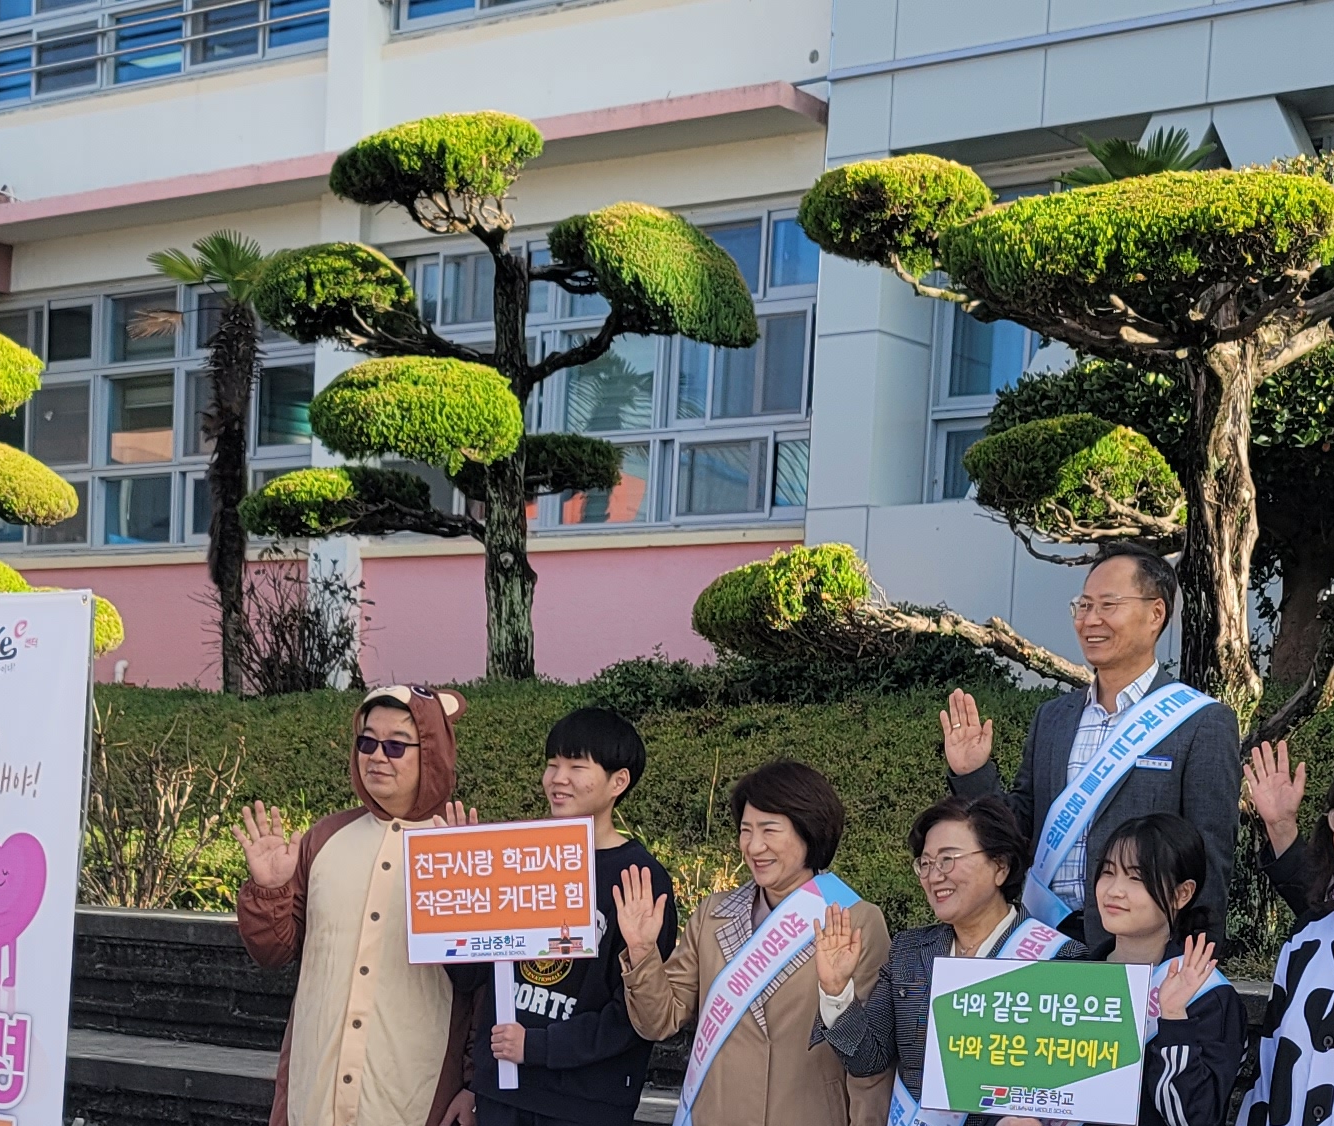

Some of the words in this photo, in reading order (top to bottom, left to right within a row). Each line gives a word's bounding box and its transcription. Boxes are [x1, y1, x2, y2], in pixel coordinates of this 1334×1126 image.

[1108, 709, 1164, 761] 빛나는
[1079, 757, 1115, 796] 너를
[1040, 793, 1087, 869] 응원해!
[414, 849, 494, 880] 친구사랑
[501, 843, 583, 875] 학교사랑
[415, 887, 491, 917] 작은관심
[498, 883, 557, 913] 커다란
[563, 881, 584, 909] 힘
[470, 935, 527, 950] 금남중학교
[727, 911, 810, 997] 생명존중
[952, 993, 987, 1017] 너와
[992, 992, 1032, 1023] 같은
[1039, 994, 1123, 1026] 마음으로
[694, 993, 734, 1067] 캠페인
[949, 1035, 983, 1060] 너와
[988, 1034, 1028, 1066] 같은
[1034, 1037, 1119, 1069] 자리에서
[1010, 1087, 1075, 1106] 금남중학교
